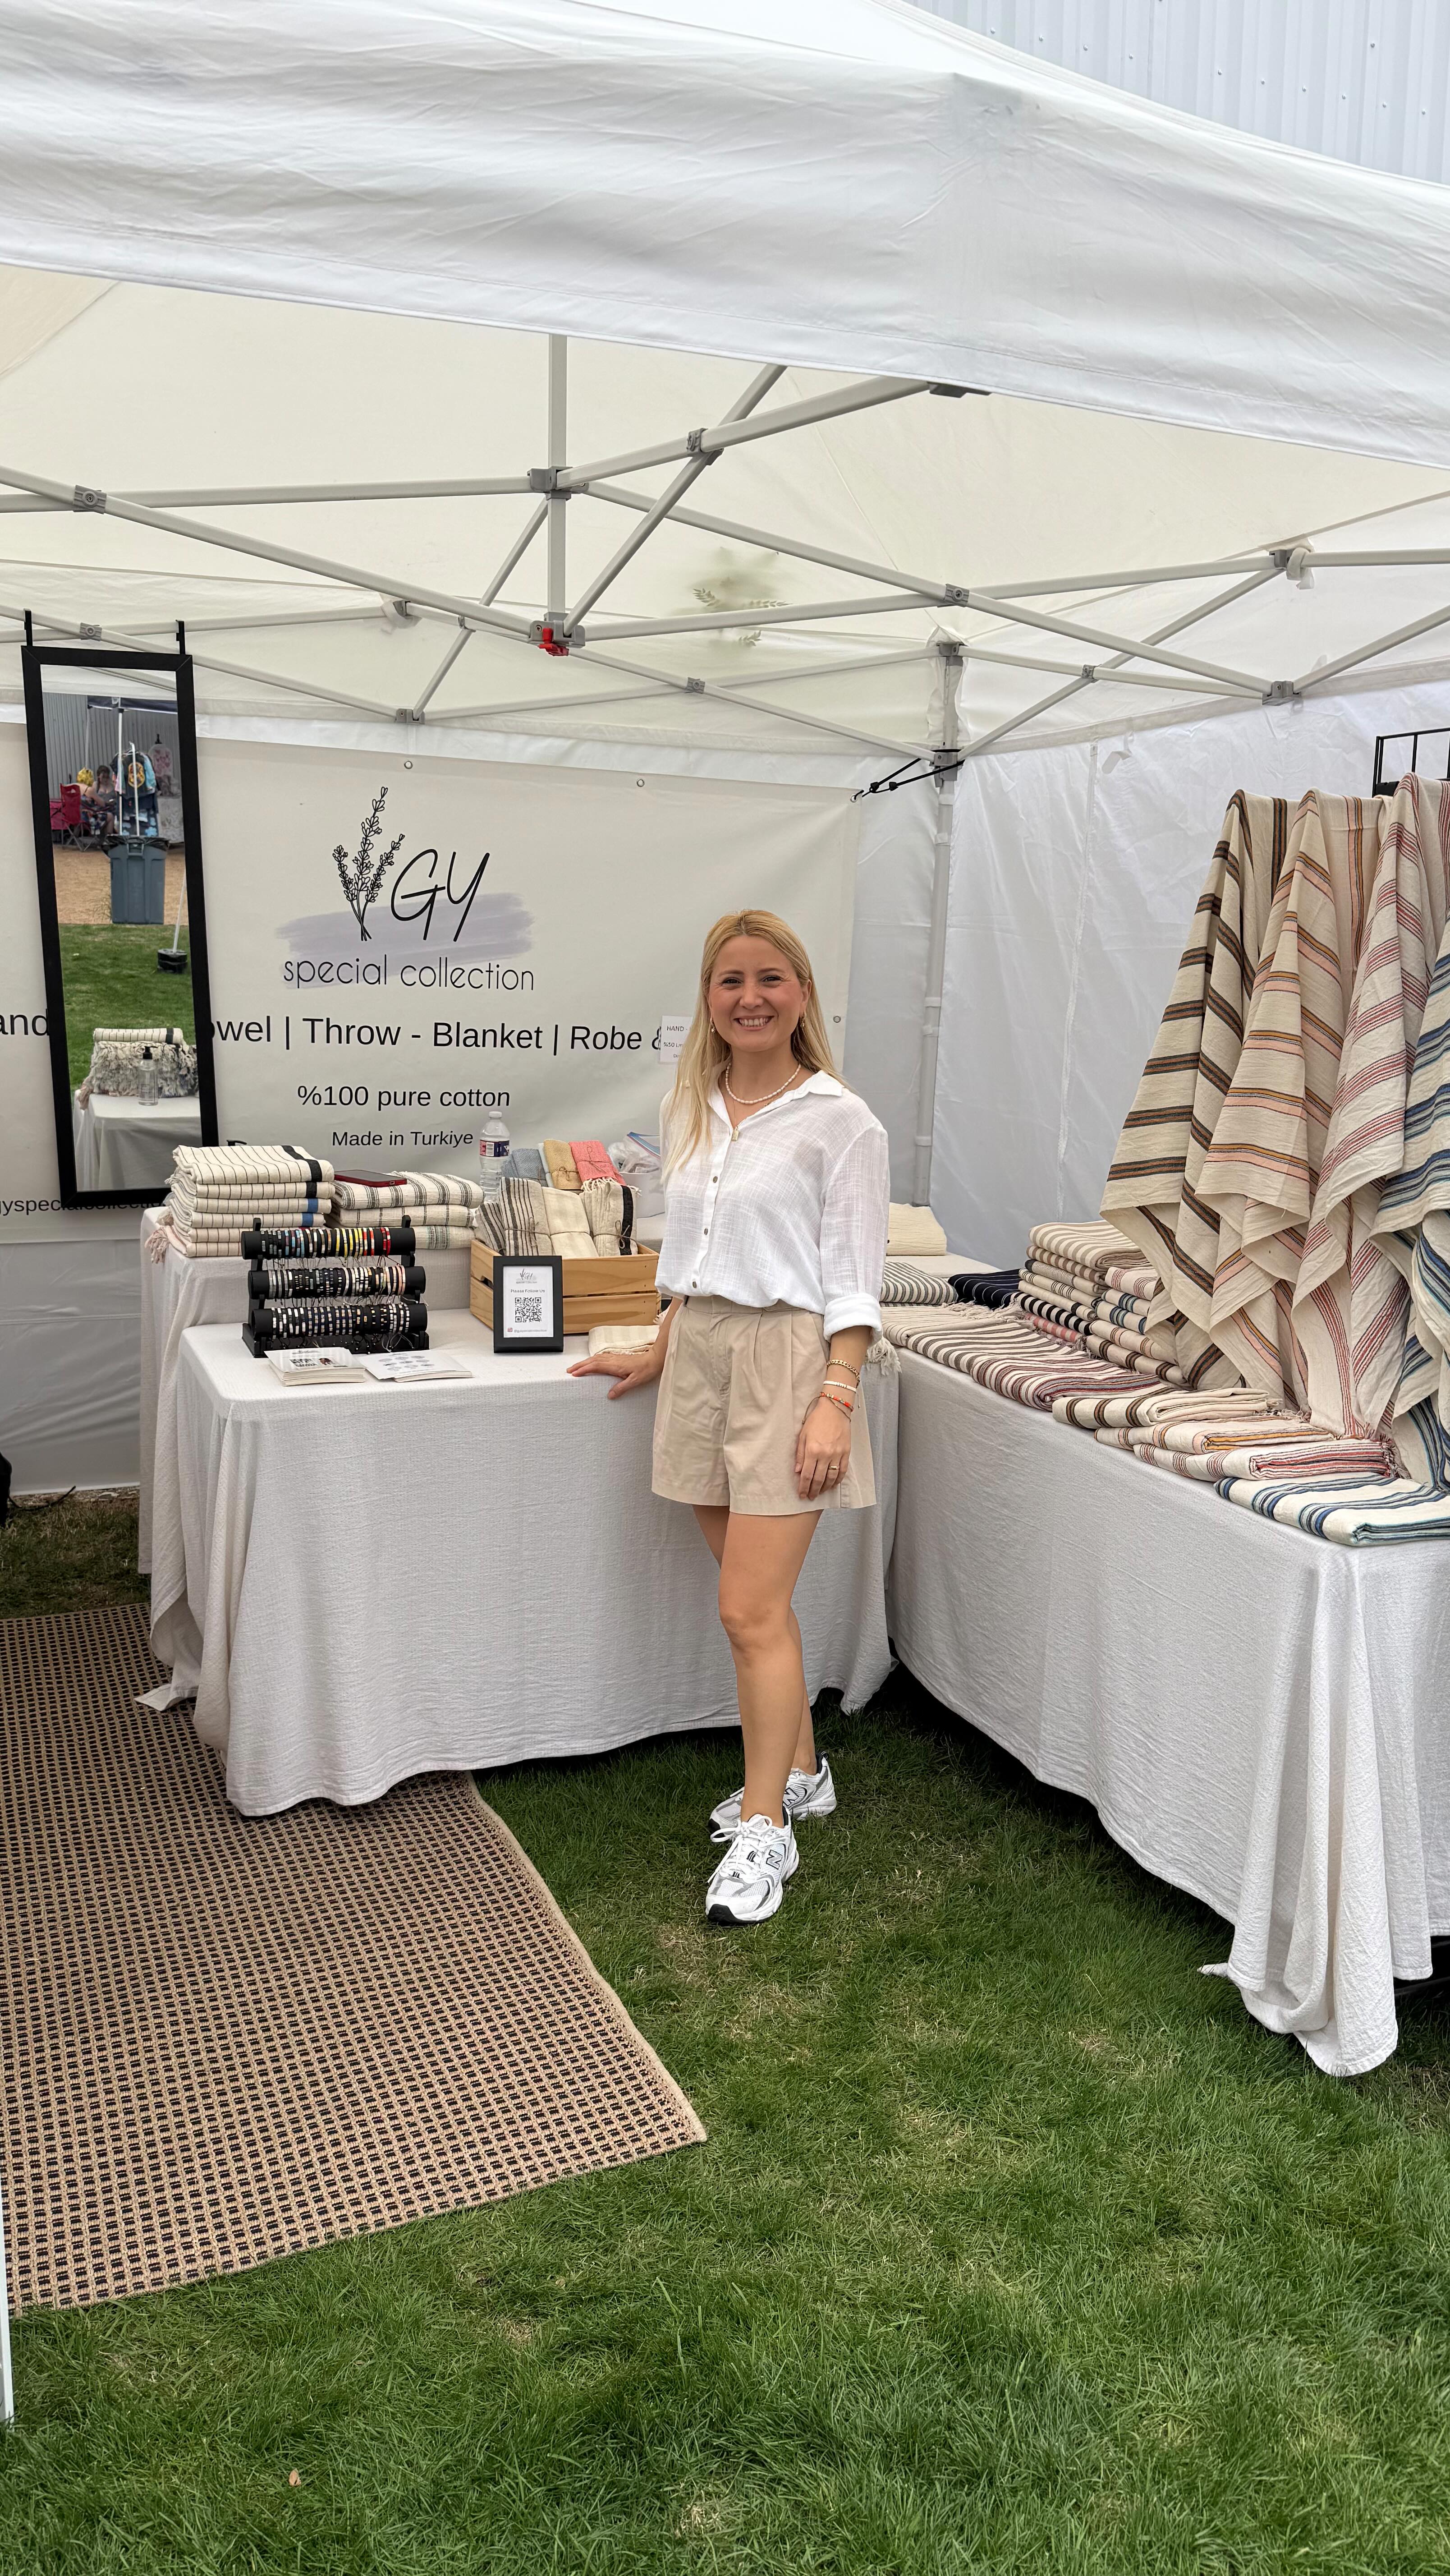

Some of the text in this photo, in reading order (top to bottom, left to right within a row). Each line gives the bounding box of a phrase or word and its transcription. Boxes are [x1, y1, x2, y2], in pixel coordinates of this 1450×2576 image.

[391, 848, 491, 942] GY
[284, 954, 533, 990] special collection
[211, 1016, 271, 1042] wel
[302, 1017, 401, 1045] Throw
[434, 1021, 543, 1049] Blanket
[570, 1026, 642, 1050] Robe
[298, 1086, 510, 1111] %100 pure cotton
[332, 1131, 383, 1146] Made
[390, 1131, 404, 1146] in
[410, 1131, 474, 1149] Turkiye
